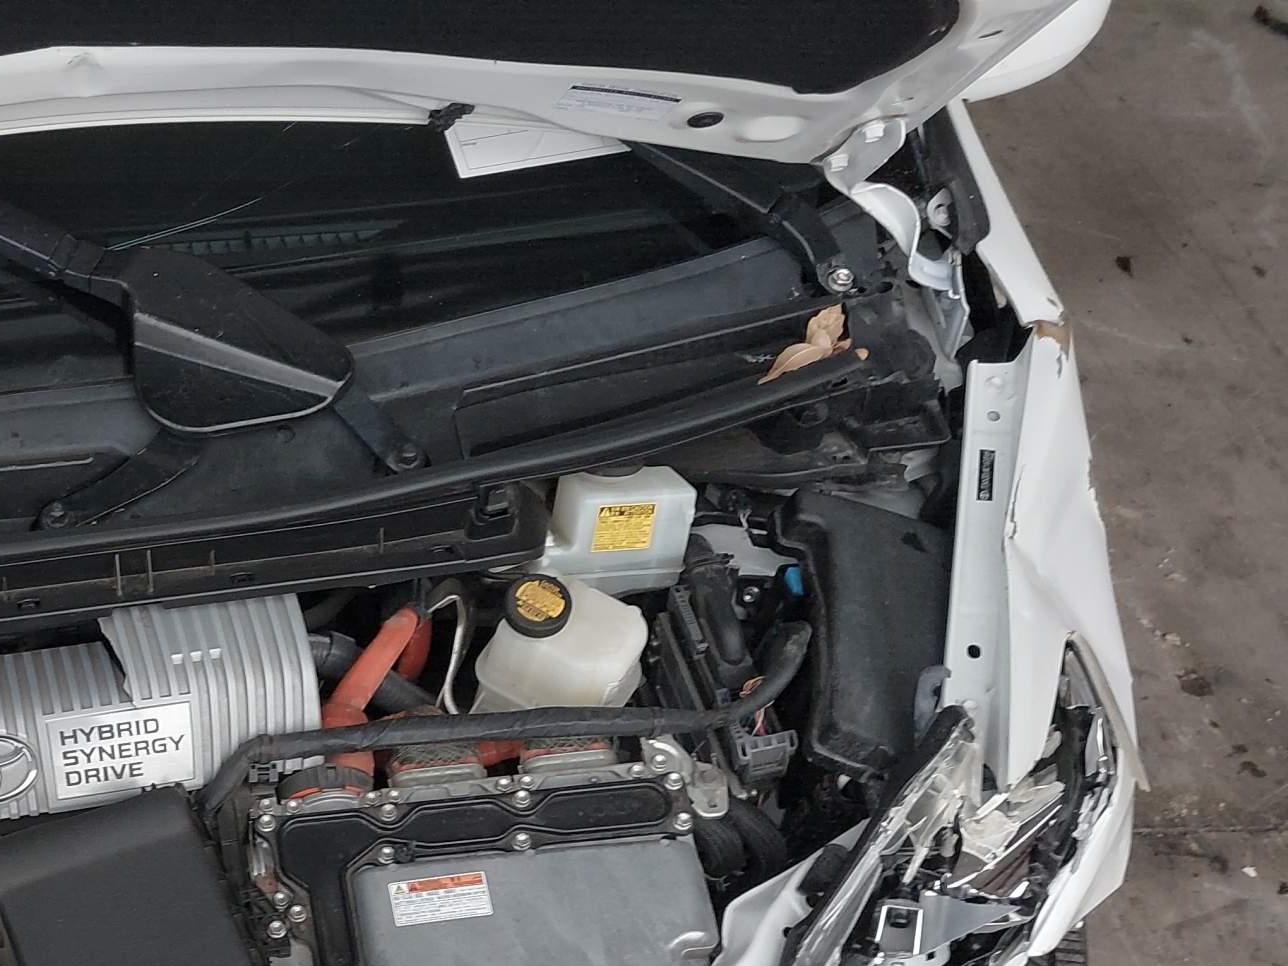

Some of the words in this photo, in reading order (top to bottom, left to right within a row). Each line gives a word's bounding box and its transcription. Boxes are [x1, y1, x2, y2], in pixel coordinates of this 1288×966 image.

[60, 718, 159, 746] HYBRID
[62, 734, 185, 766] SYNERGY
[65, 761, 144, 787] DRIVE
